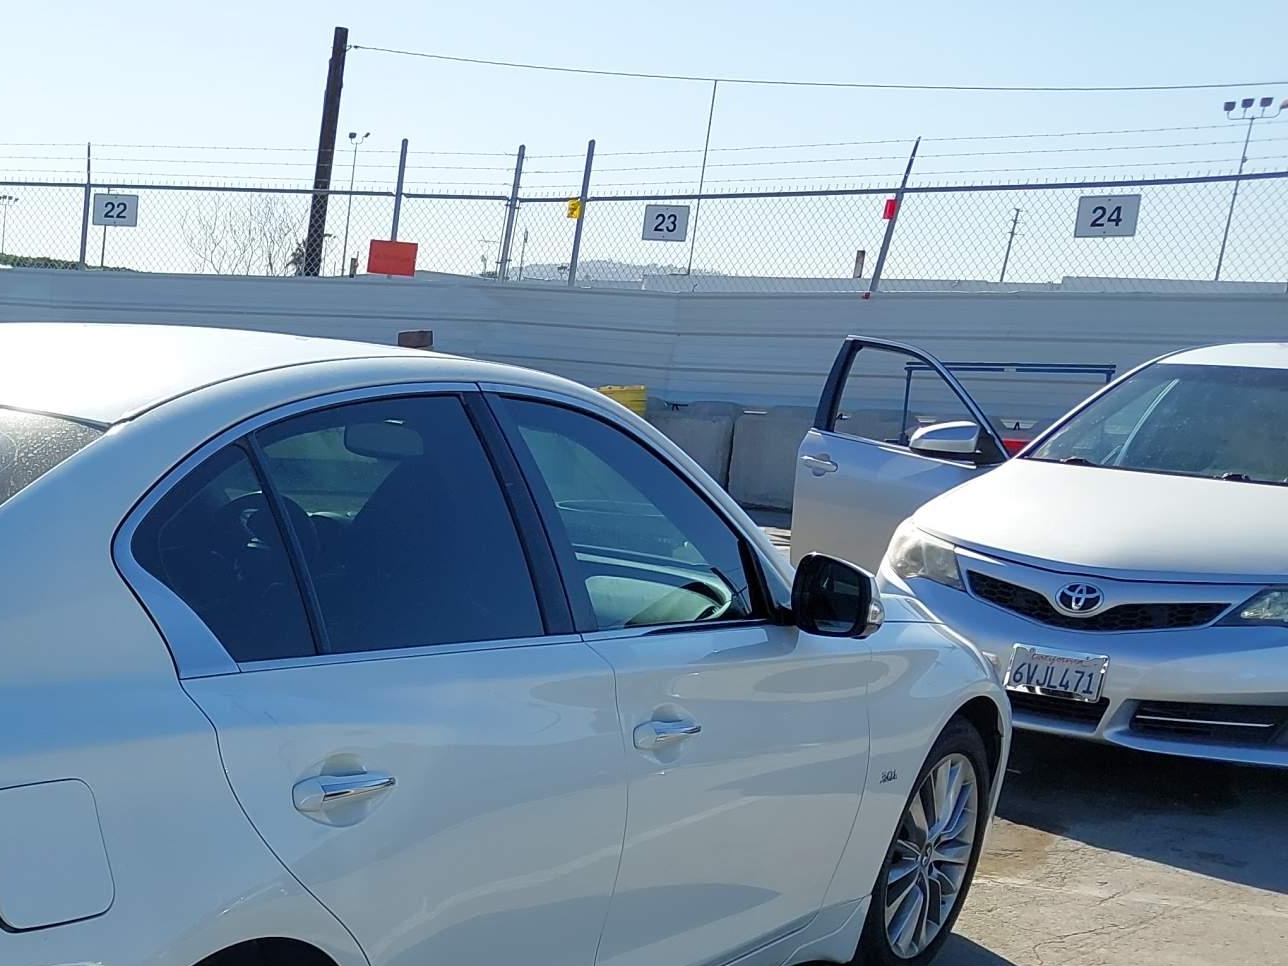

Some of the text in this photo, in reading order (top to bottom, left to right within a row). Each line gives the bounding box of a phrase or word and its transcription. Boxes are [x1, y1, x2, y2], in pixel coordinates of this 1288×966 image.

[103, 201, 127, 219] 22
[1090, 205, 1122, 228] 24
[653, 213, 678, 233] 23
[1013, 663, 1095, 695] 6VJL471
